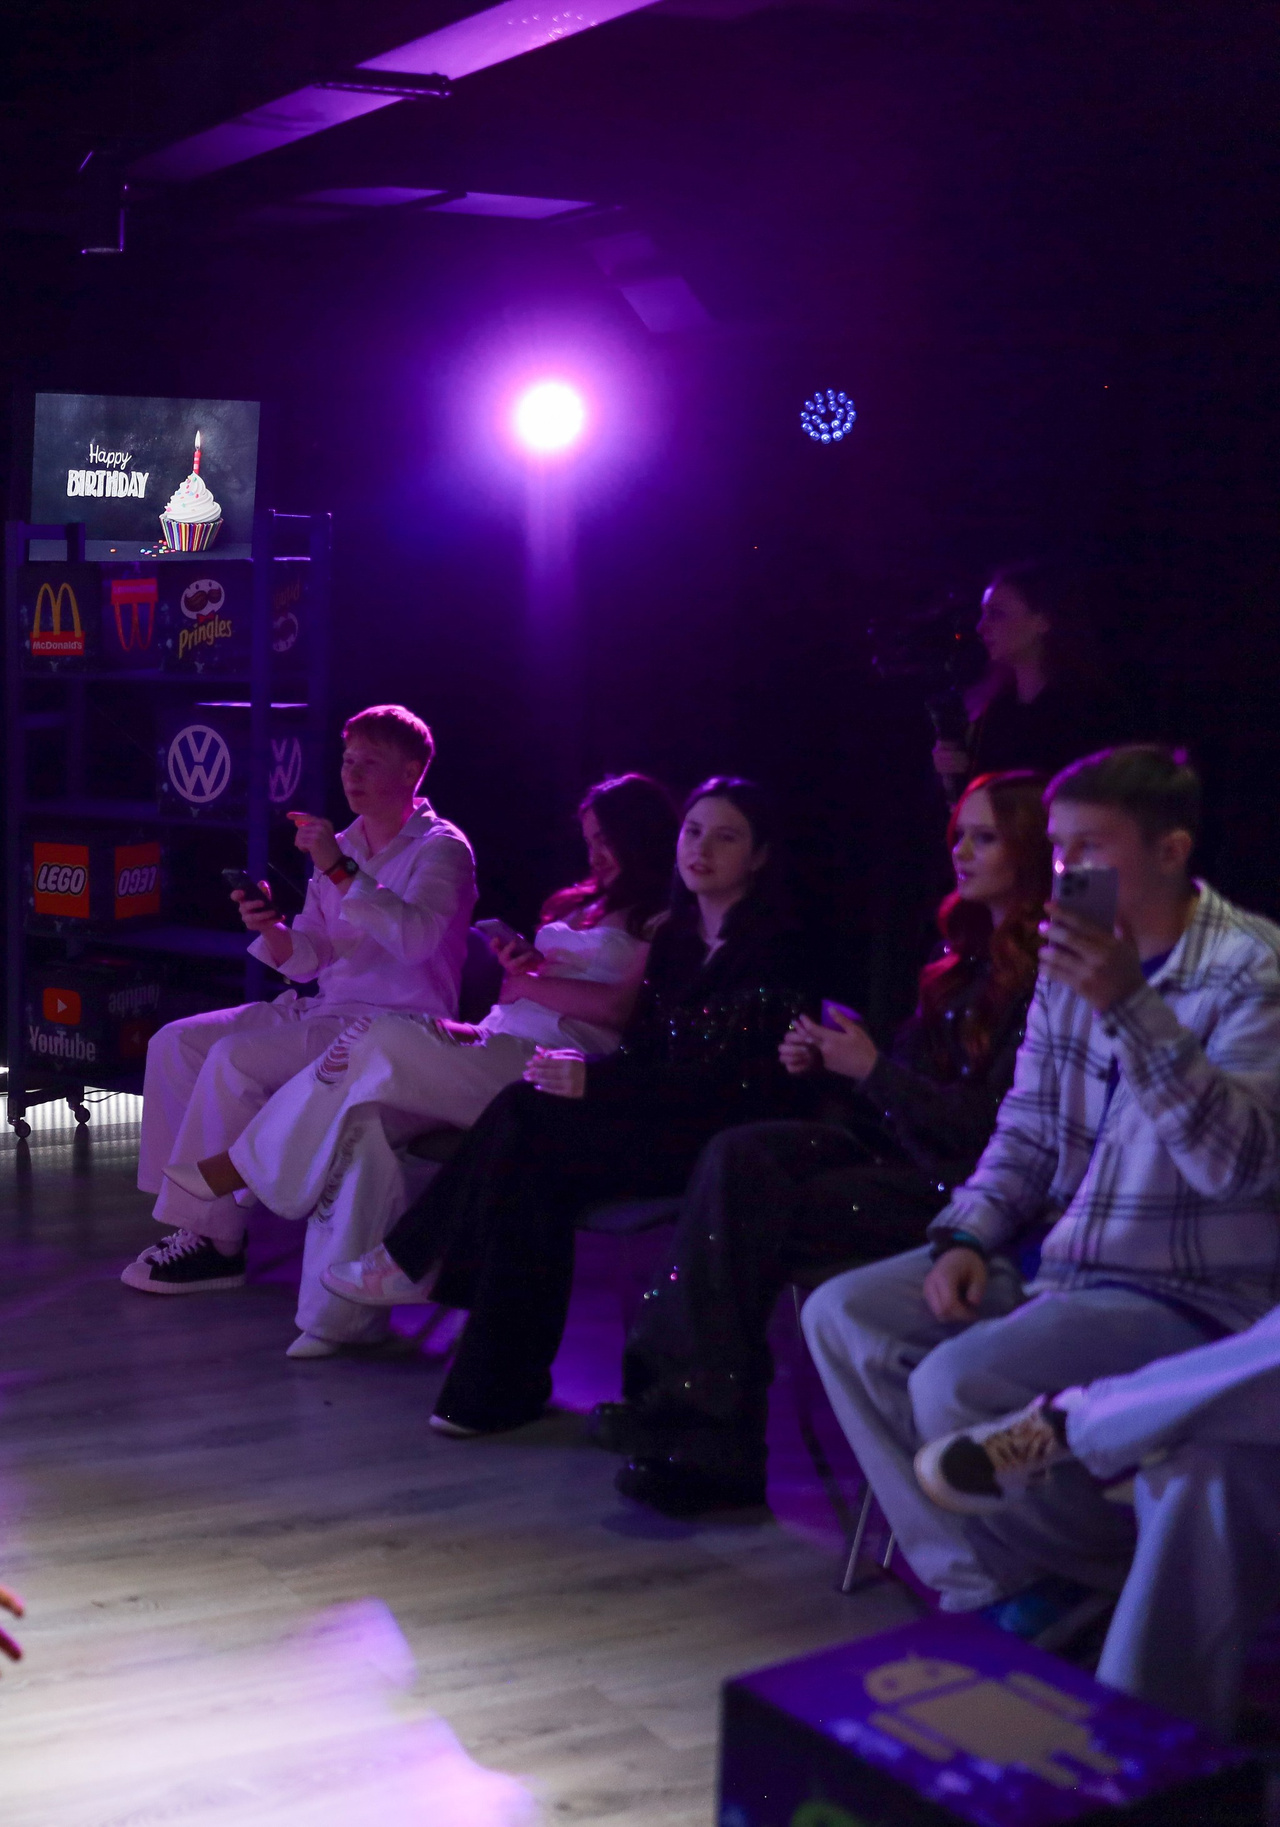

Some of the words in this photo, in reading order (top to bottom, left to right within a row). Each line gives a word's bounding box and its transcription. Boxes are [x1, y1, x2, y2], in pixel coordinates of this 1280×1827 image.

[89, 443, 132, 470] Happy
[67, 469, 149, 499] BIRTHDAY
[178, 614, 233, 660] Pringles
[36, 863, 86, 896] LEGO
[29, 1024, 97, 1062] YouTube
